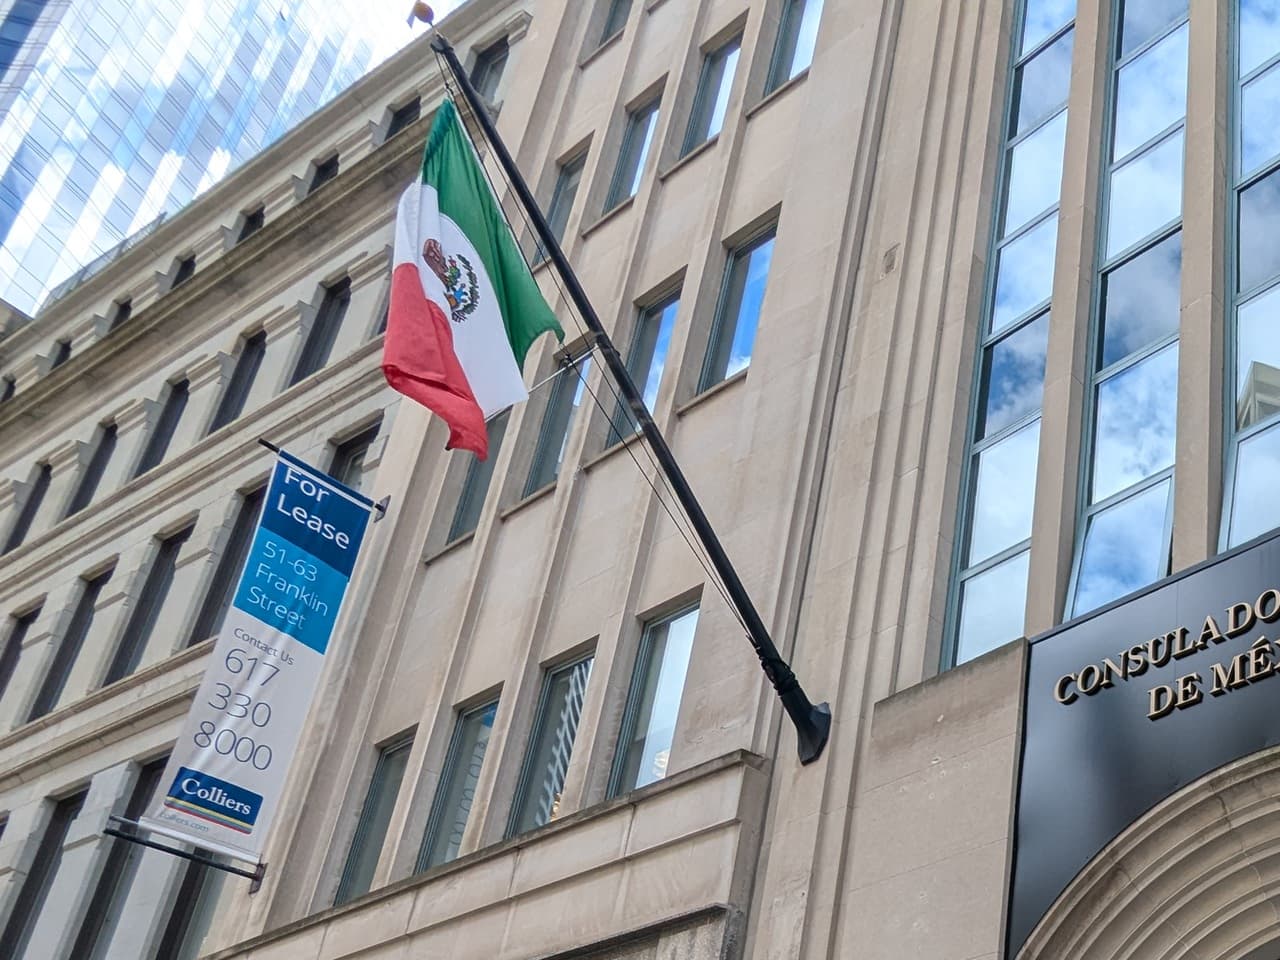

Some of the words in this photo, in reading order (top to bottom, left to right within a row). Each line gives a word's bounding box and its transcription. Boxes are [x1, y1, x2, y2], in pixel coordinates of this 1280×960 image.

[283, 468, 330, 504] For
[276, 493, 350, 549] Lease
[263, 540, 318, 582] 51-63
[247, 586, 305, 630] Street
[256, 563, 328, 617] Franklin
[225, 648, 280, 688] 617
[234, 627, 278, 658] Contact
[281, 648, 294, 666] Us
[208, 683, 271, 728] 330
[1146, 672, 1202, 721] DE
[193, 721, 272, 771] 8000
[181, 778, 251, 815] Colliers
